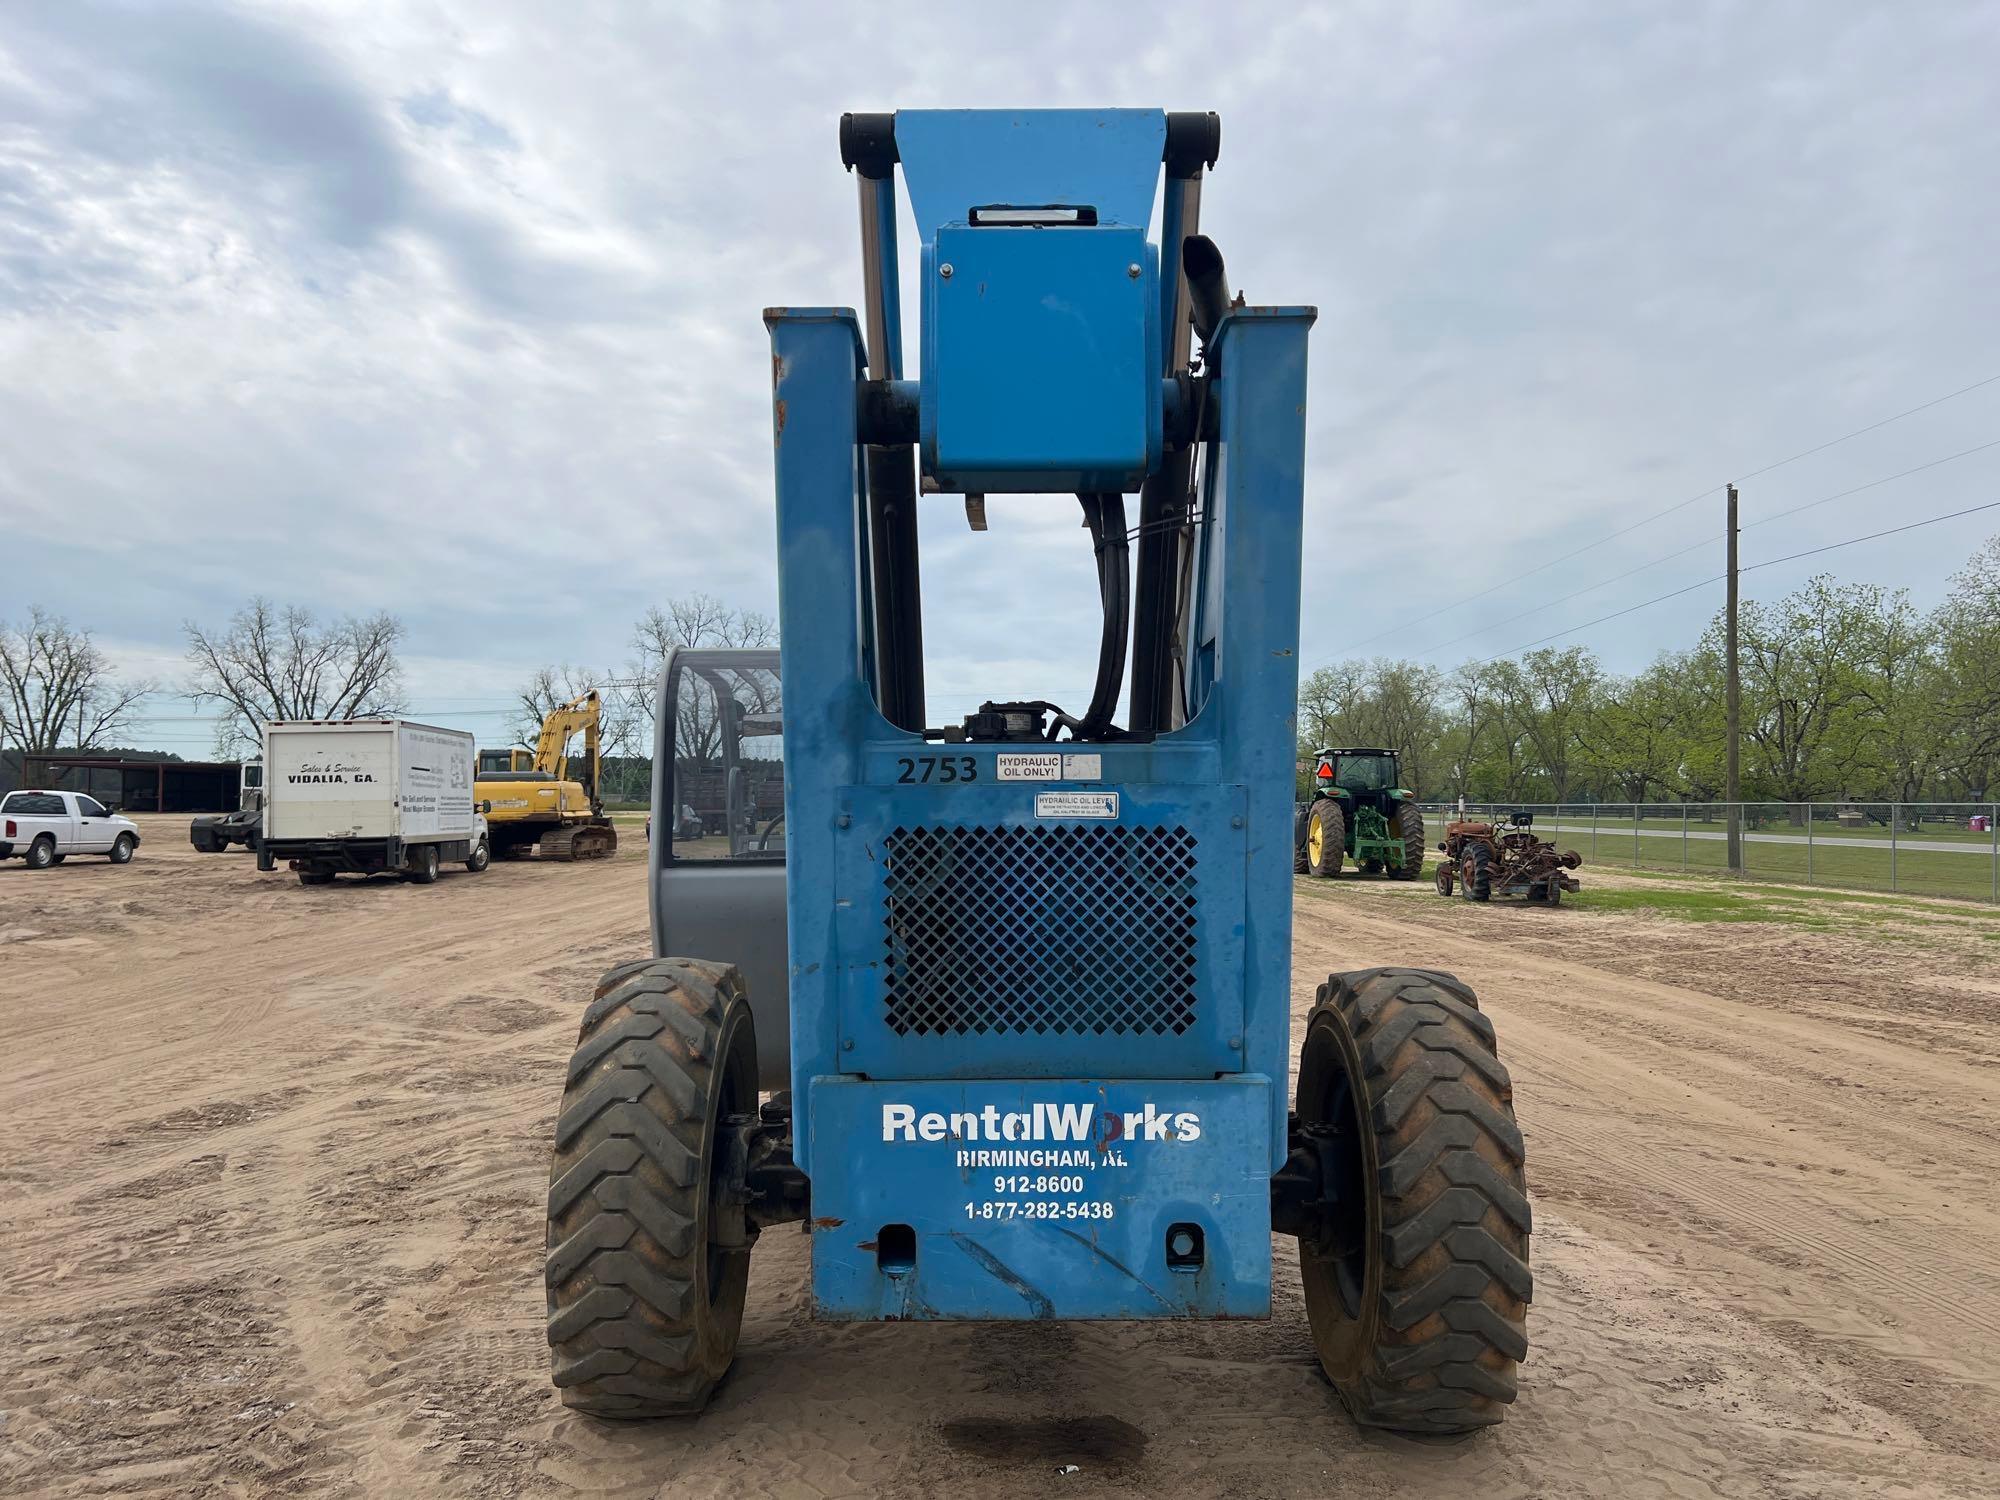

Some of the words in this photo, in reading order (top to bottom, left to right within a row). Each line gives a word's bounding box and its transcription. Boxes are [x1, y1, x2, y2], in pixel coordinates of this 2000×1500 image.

[301, 764, 321, 773] Sales
[325, 764, 331, 773] &
[898, 757, 977, 784] 2753
[999, 757, 1059, 766] HYDRAULIC
[288, 775, 348, 784] VIDALIA,
[354, 774, 378, 783] GA.
[1004, 768, 1021, 776] OIL
[1024, 768, 1054, 776] ONLY!
[882, 1103, 1201, 1142] RentalWorks
[956, 1150, 1096, 1171] BIRMINGHAM,
[1102, 1150, 1128, 1167] AL
[994, 1175, 1084, 1193] 912-8600
[964, 1201, 1114, 1219] 1-877-282-5438
